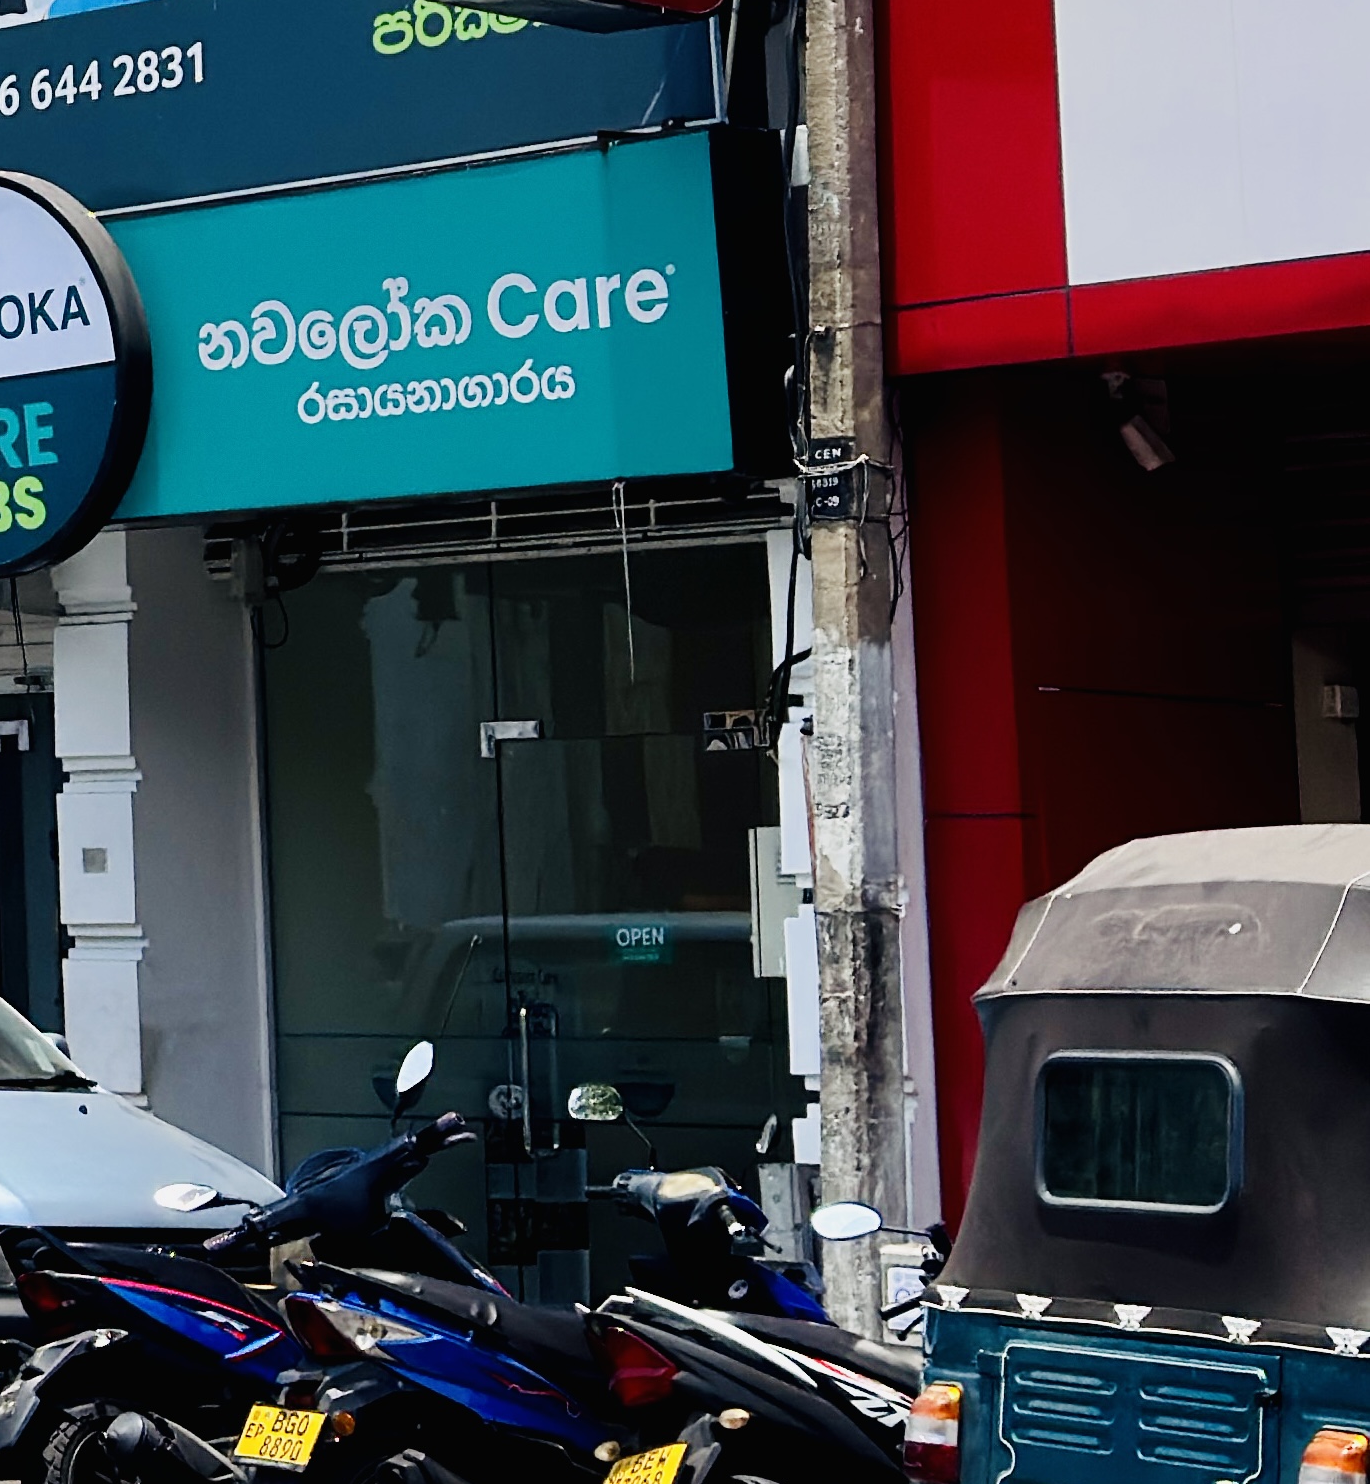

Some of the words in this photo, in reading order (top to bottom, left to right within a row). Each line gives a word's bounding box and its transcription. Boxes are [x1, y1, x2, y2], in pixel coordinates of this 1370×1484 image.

[31, 59, 102, 111] 644
[113, 41, 204, 97] 2831
[198, 276, 472, 370] නවලෝක
[486, 268, 670, 339] Care
[297, 358, 575, 424] රසායනාගාරය
[616, 926, 664, 946] OPEN
